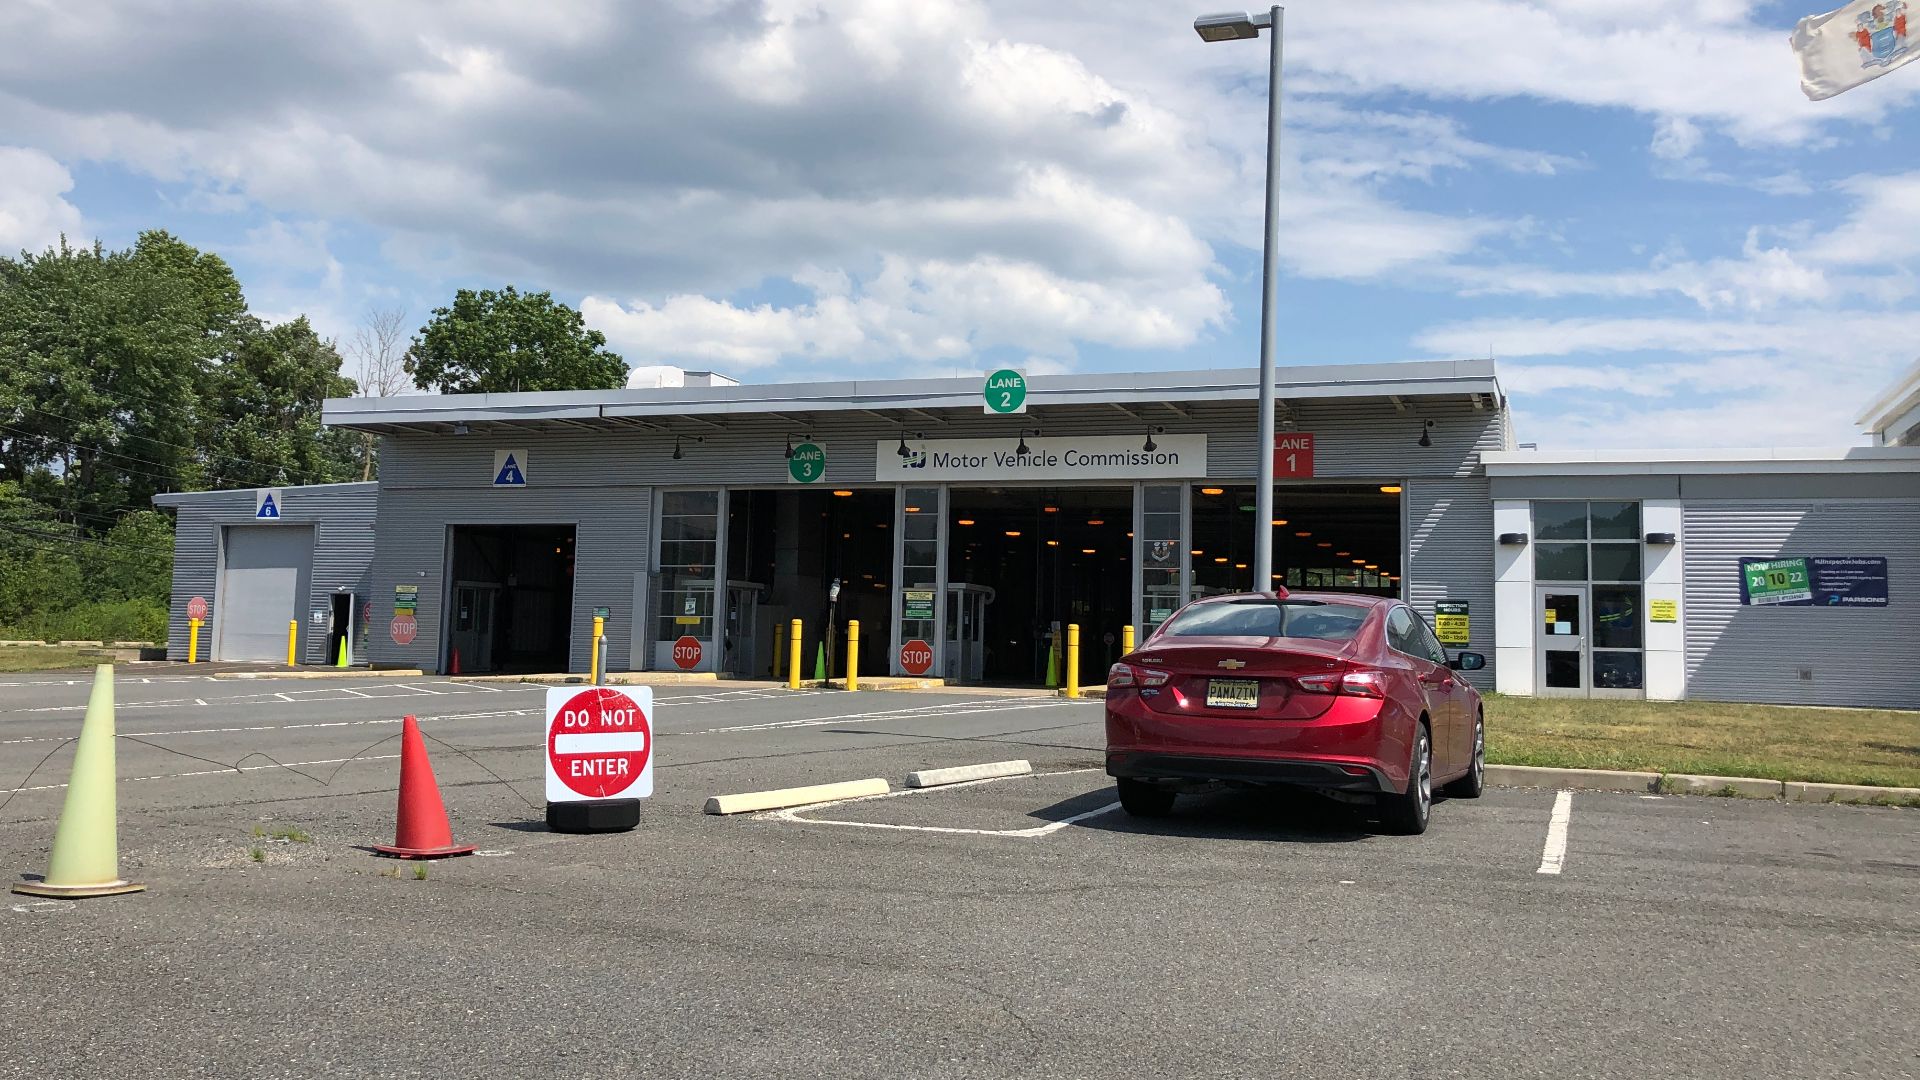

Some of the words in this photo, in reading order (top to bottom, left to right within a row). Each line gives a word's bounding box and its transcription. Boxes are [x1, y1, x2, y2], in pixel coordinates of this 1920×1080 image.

[989, 377, 1021, 389] LANE
[1000, 391, 1011, 407] 2
[1273, 438, 1310, 449] LANE
[793, 450, 821, 461] LANE
[933, 451, 988, 468] Motor
[993, 449, 1058, 468] Vehicle
[1064, 449, 1179, 467] Commission
[1286, 453, 1296, 472] 1
[505, 469, 514, 483] 4
[802, 462, 812, 477] 3
[265, 506, 272, 516] 6
[1747, 562, 1769, 572] NOW
[1771, 559, 1803, 570] HIRING
[1752, 576, 1765, 587] 20
[1768, 572, 1786, 586] 10
[1790, 571, 1804, 583] 22
[189, 604, 206, 614] STOP
[392, 622, 416, 635] STOP
[674, 646, 701, 660] STOP
[902, 650, 931, 664] STOP
[1209, 685, 1256, 701] PAMAZIN
[564, 709, 589, 727] DO
[600, 709, 635, 726] NOT
[571, 758, 629, 777] ENTER
